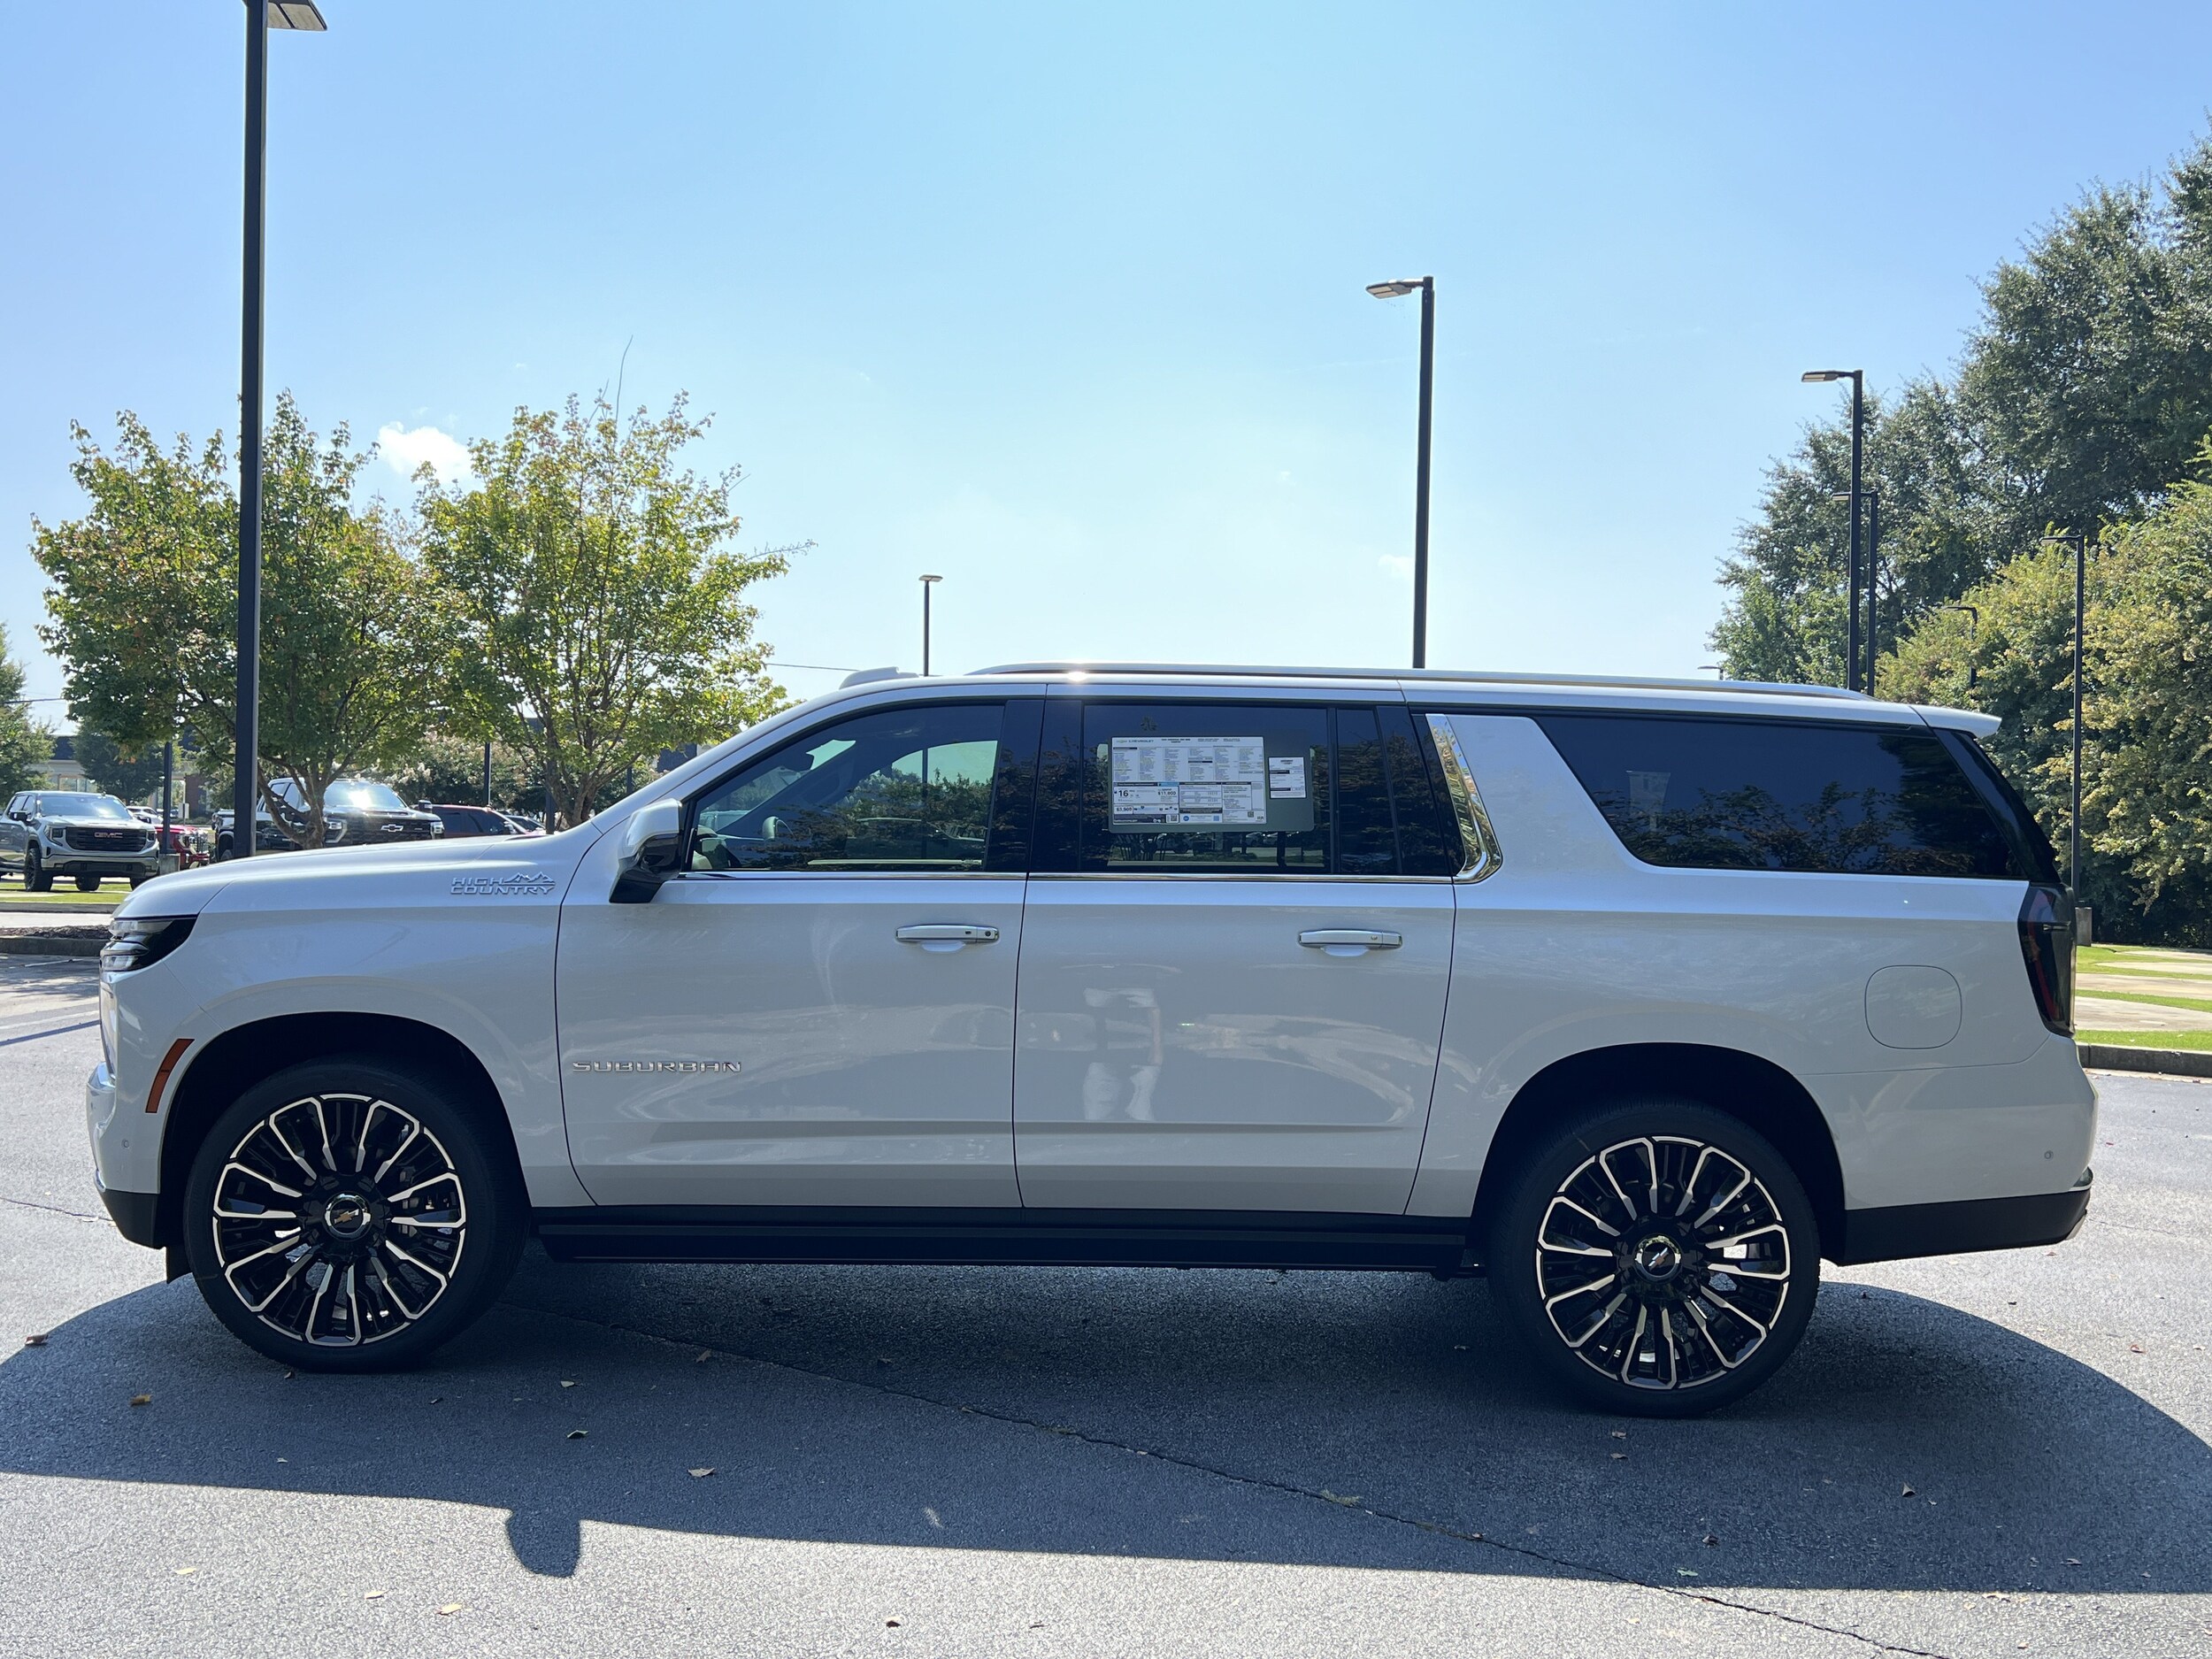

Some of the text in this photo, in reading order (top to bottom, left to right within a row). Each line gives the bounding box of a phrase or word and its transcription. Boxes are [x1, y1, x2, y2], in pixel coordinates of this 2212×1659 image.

[451, 877, 505, 886] HIGH
[450, 886, 556, 895] COUNTRY
[572, 1061, 743, 1073] SUBURBAN
